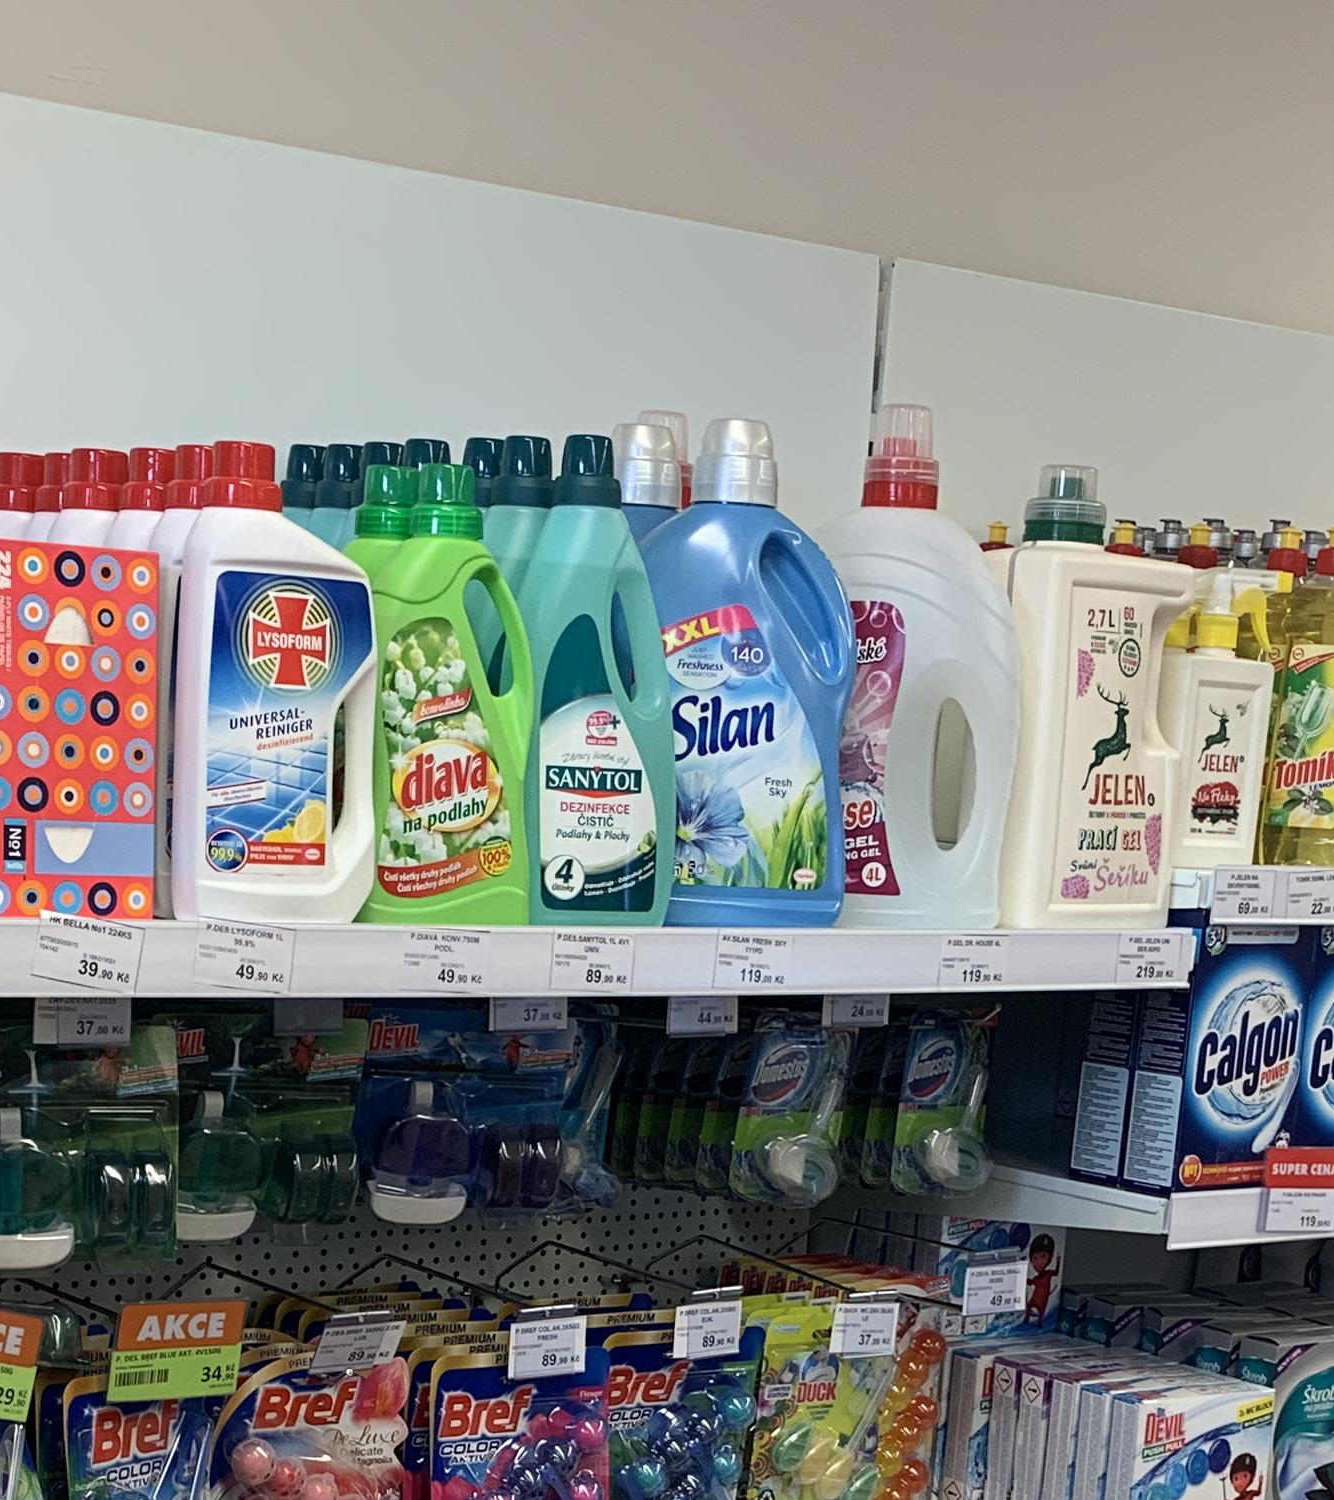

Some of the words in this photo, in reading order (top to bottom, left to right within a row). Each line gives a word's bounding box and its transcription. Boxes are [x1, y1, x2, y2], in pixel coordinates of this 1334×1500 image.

[256, 630, 323, 651] LYSOFORM
[730, 646, 764, 664] 140
[229, 708, 305, 730] UNIVERSAL-
[256, 719, 313, 740] REINIGER
[674, 695, 775, 761] Silan
[400, 749, 488, 810] diava
[549, 766, 642, 792] SANYTOL
[764, 777, 793, 789] Fresh
[1088, 774, 1146, 807] JELEN
[768, 787, 788, 798] Sky
[403, 819, 423, 834] na
[428, 797, 488, 832] podlahy
[560, 802, 631, 816] DEZINFEKCE
[577, 814, 614, 829] ČISTIČ
[1122, 829, 1142, 853] GEL
[1195, 1009, 1299, 1098] Calgon
[1272, 1161, 1306, 1176] SUPER
[136, 1312, 227, 1342] AKCE
[253, 1382, 357, 1429] Bref
[438, 1389, 537, 1438] Bref
[92, 1404, 178, 1465] Bref
[440, 1440, 500, 1457] COLOR
